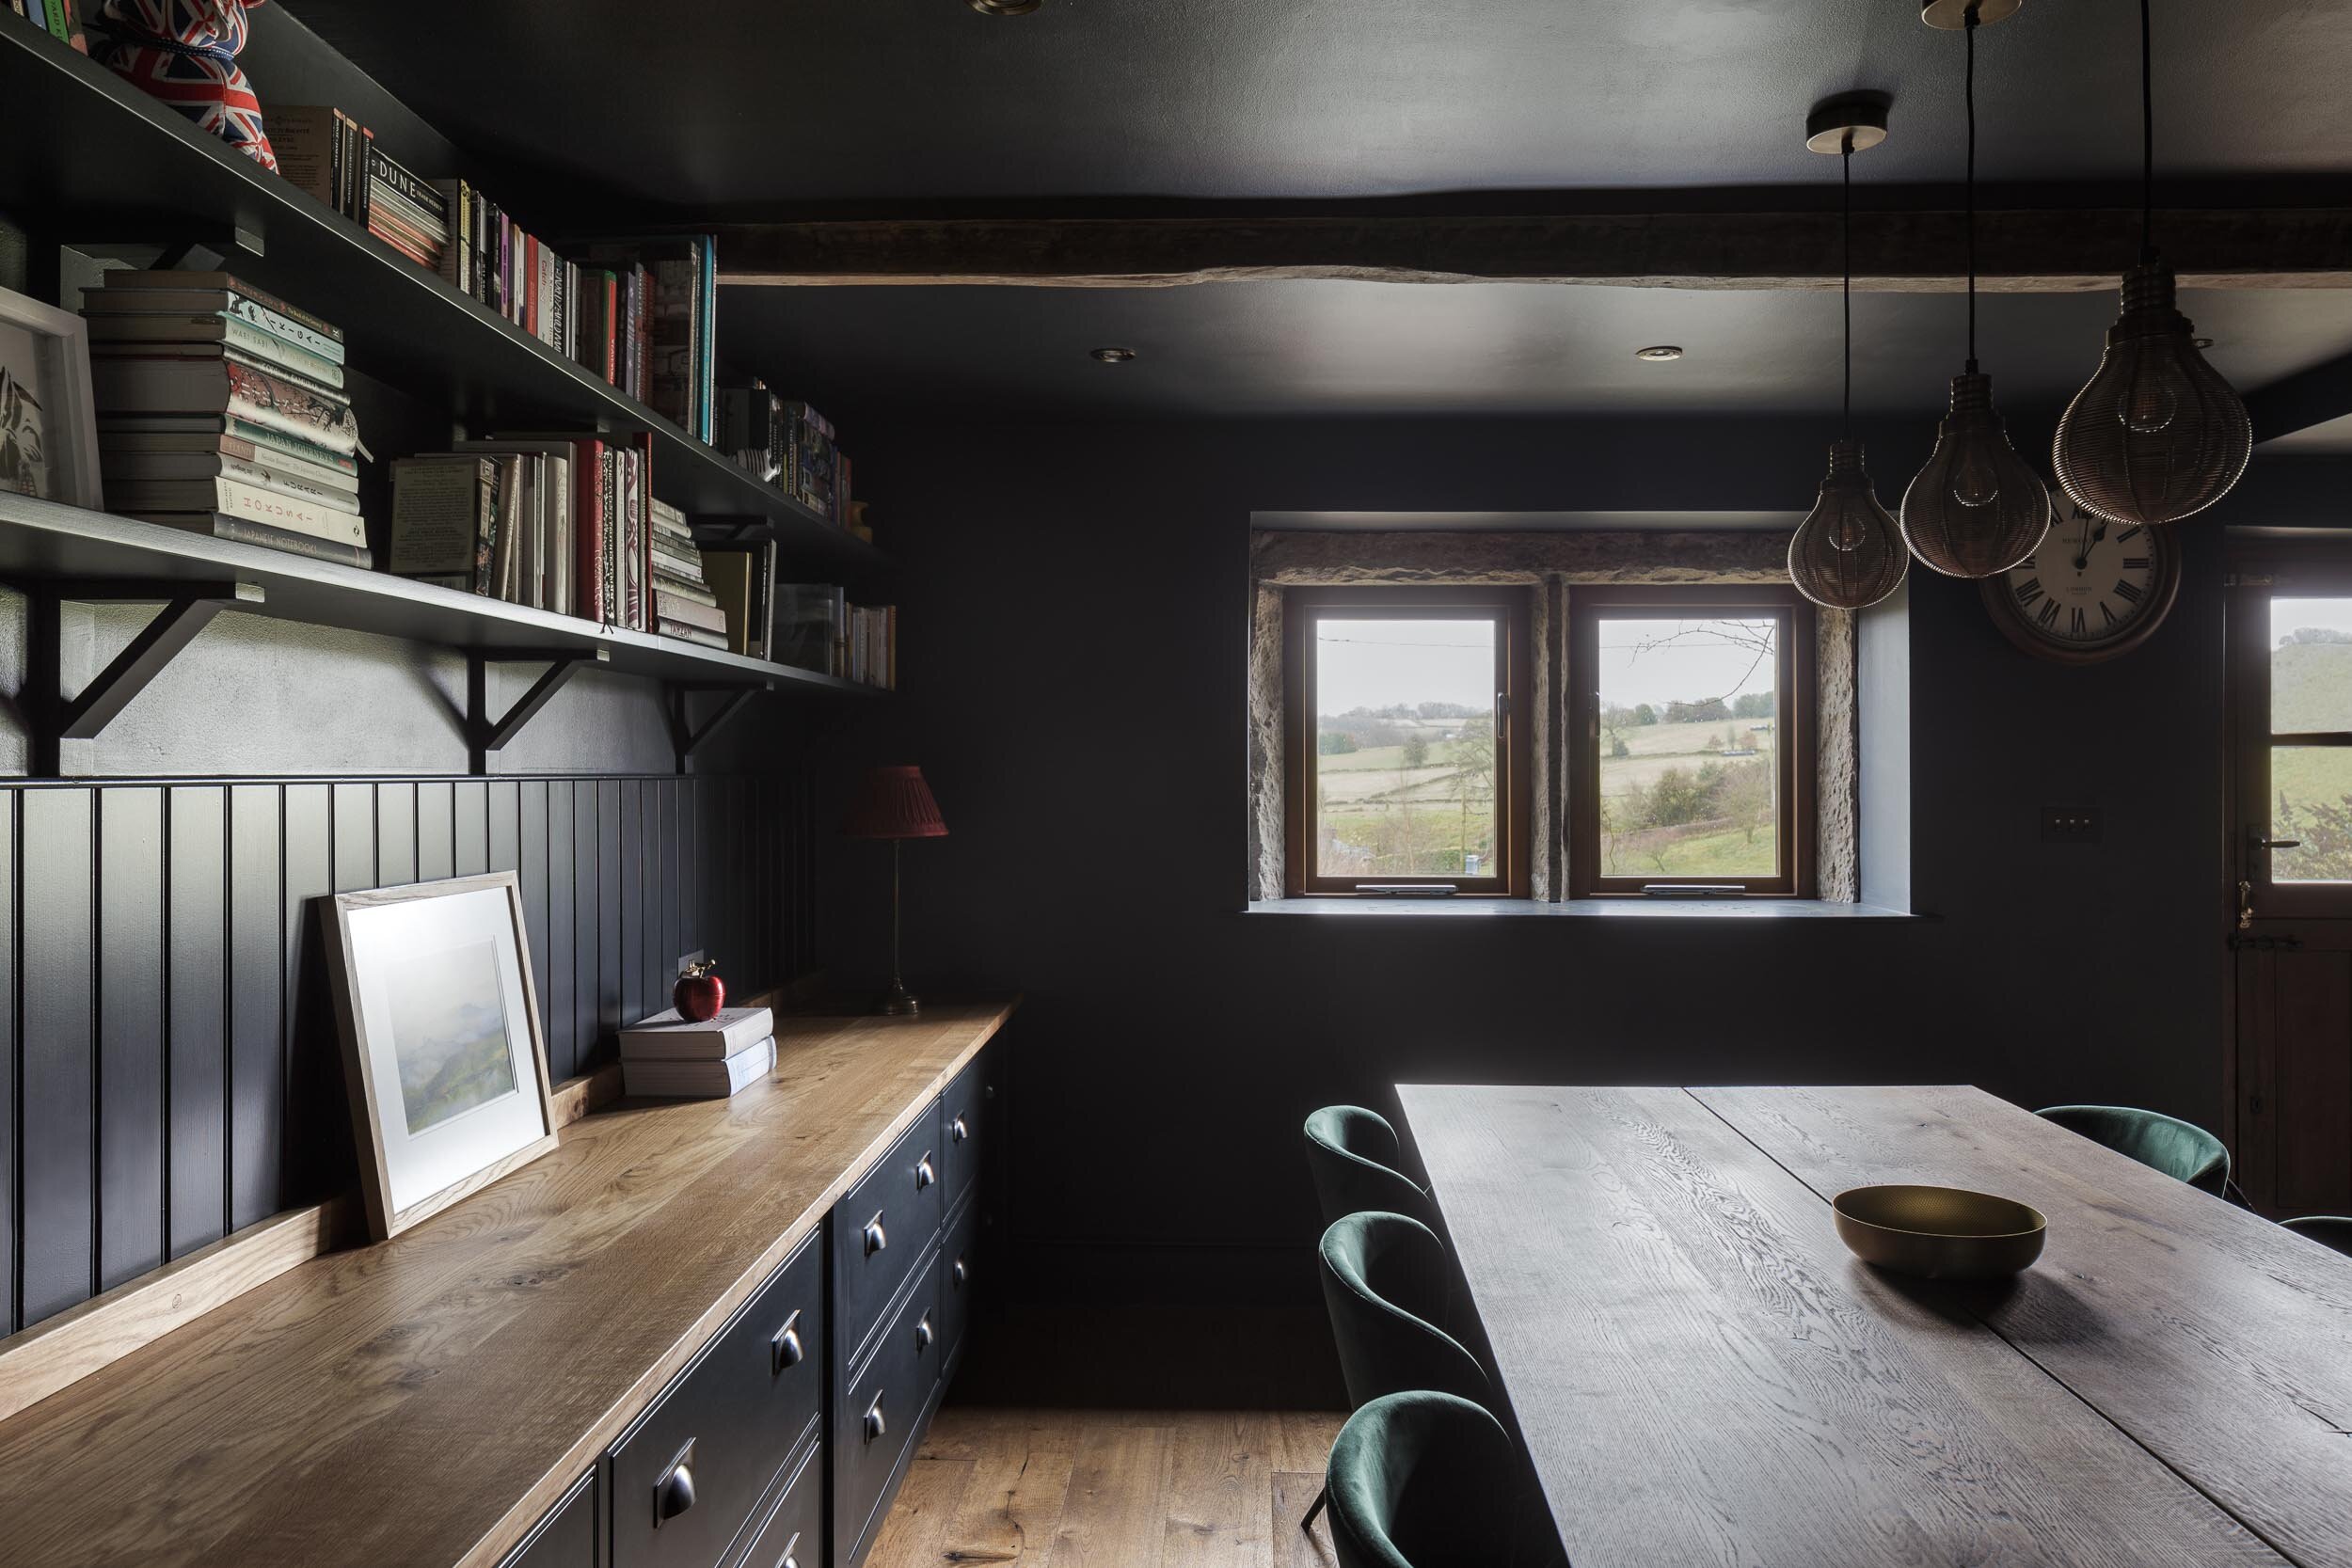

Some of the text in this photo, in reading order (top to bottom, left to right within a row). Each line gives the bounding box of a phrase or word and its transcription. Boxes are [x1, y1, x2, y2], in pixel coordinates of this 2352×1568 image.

[379, 160, 416, 198] DUNE
[232, 326, 269, 349] WABI SABI
[269, 319, 321, 345] IKIGAI
[265, 433, 334, 462] JAPAN JOURNEYS
[283, 480, 324, 497] FURARI
[243, 496, 313, 522] HOKUSAI
[246, 529, 317, 555] JAPANESE NOTEBOOKS
[670, 621, 693, 641] TARZAN
